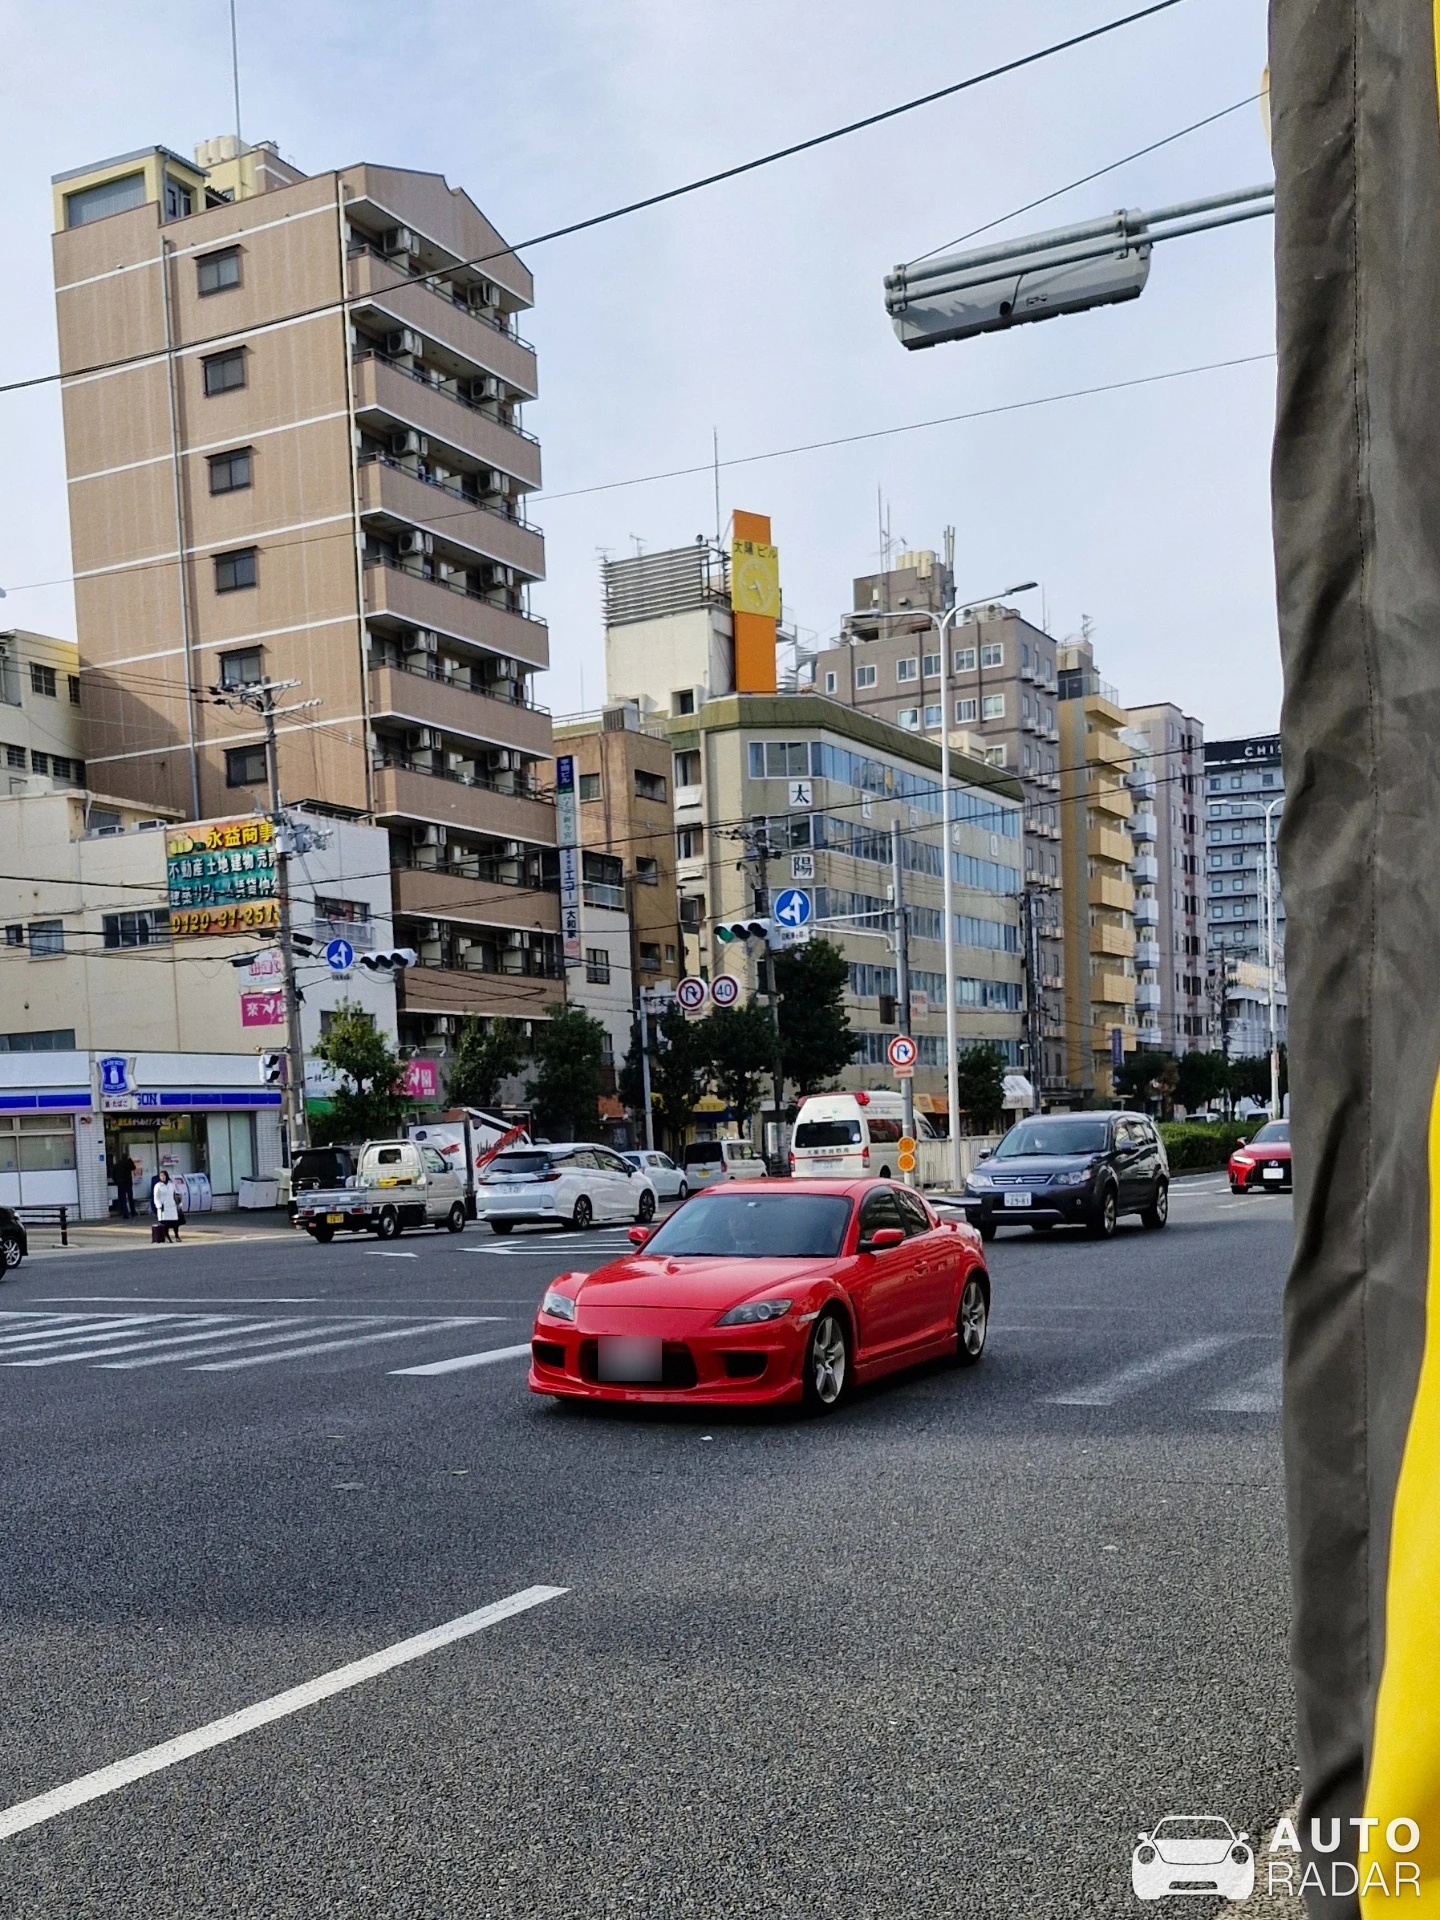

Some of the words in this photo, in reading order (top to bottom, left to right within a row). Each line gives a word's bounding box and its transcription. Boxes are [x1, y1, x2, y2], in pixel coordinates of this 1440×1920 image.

[168, 857, 204, 880] 不動産
[716, 983, 732, 997] 40
